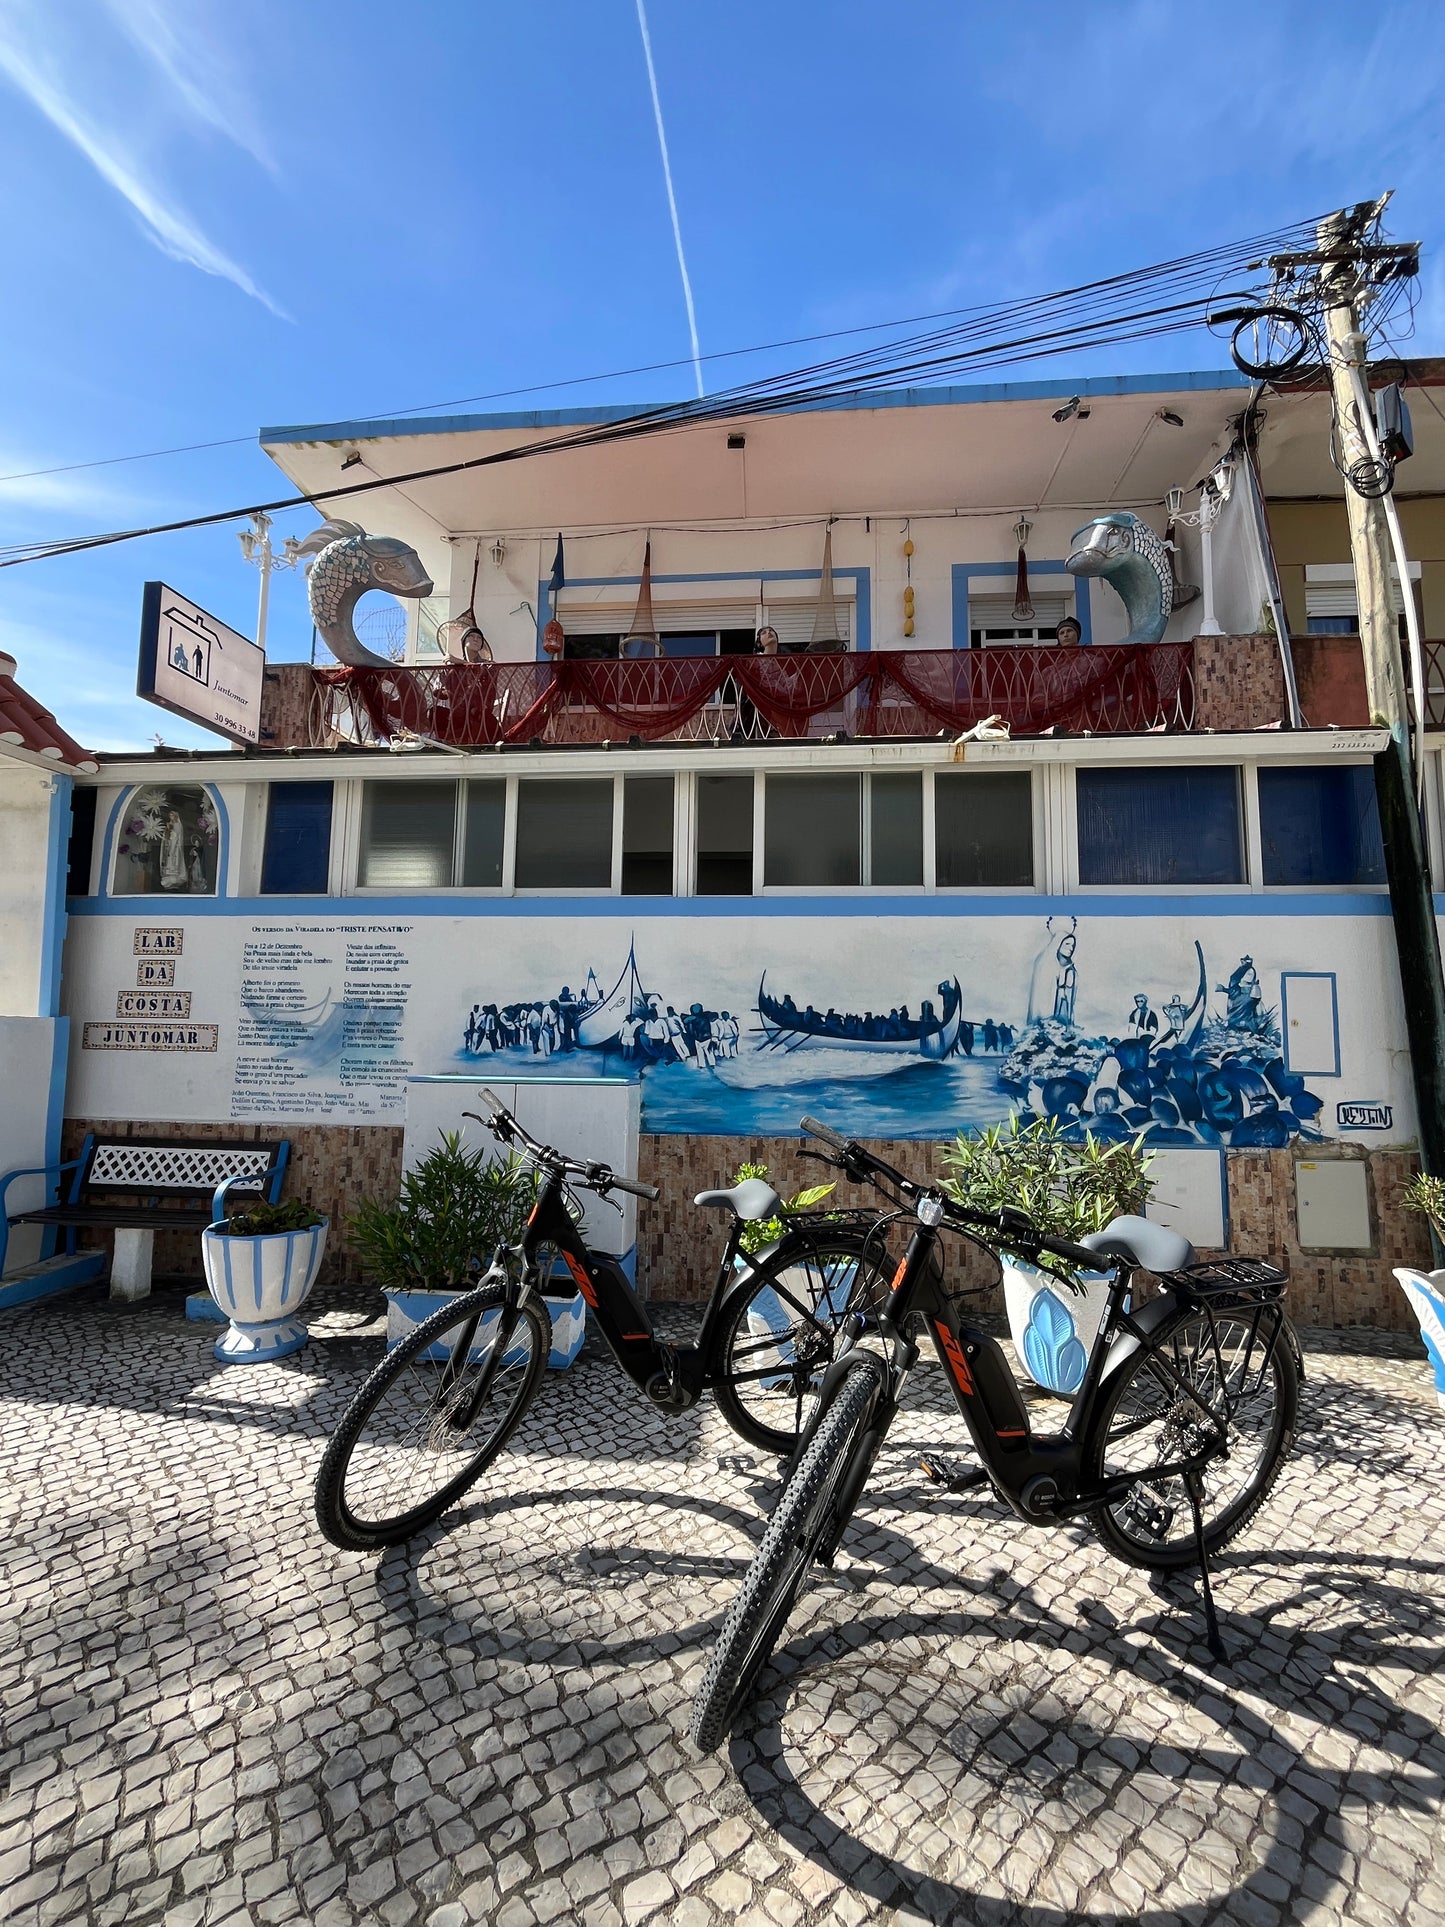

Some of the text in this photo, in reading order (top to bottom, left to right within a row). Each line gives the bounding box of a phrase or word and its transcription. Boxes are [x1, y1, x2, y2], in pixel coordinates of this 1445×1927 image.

[213, 680, 248, 706] Juntomar
[214, 712, 256, 739] 30 996 33 48
[141, 935, 176, 948] LAR
[144, 966, 167, 979] DA
[124, 998, 183, 1011] COSTA
[103, 1030, 198, 1044] JUNTOMAR
[561, 1249, 599, 1308] KTM
[934, 1320, 974, 1396] KTM
